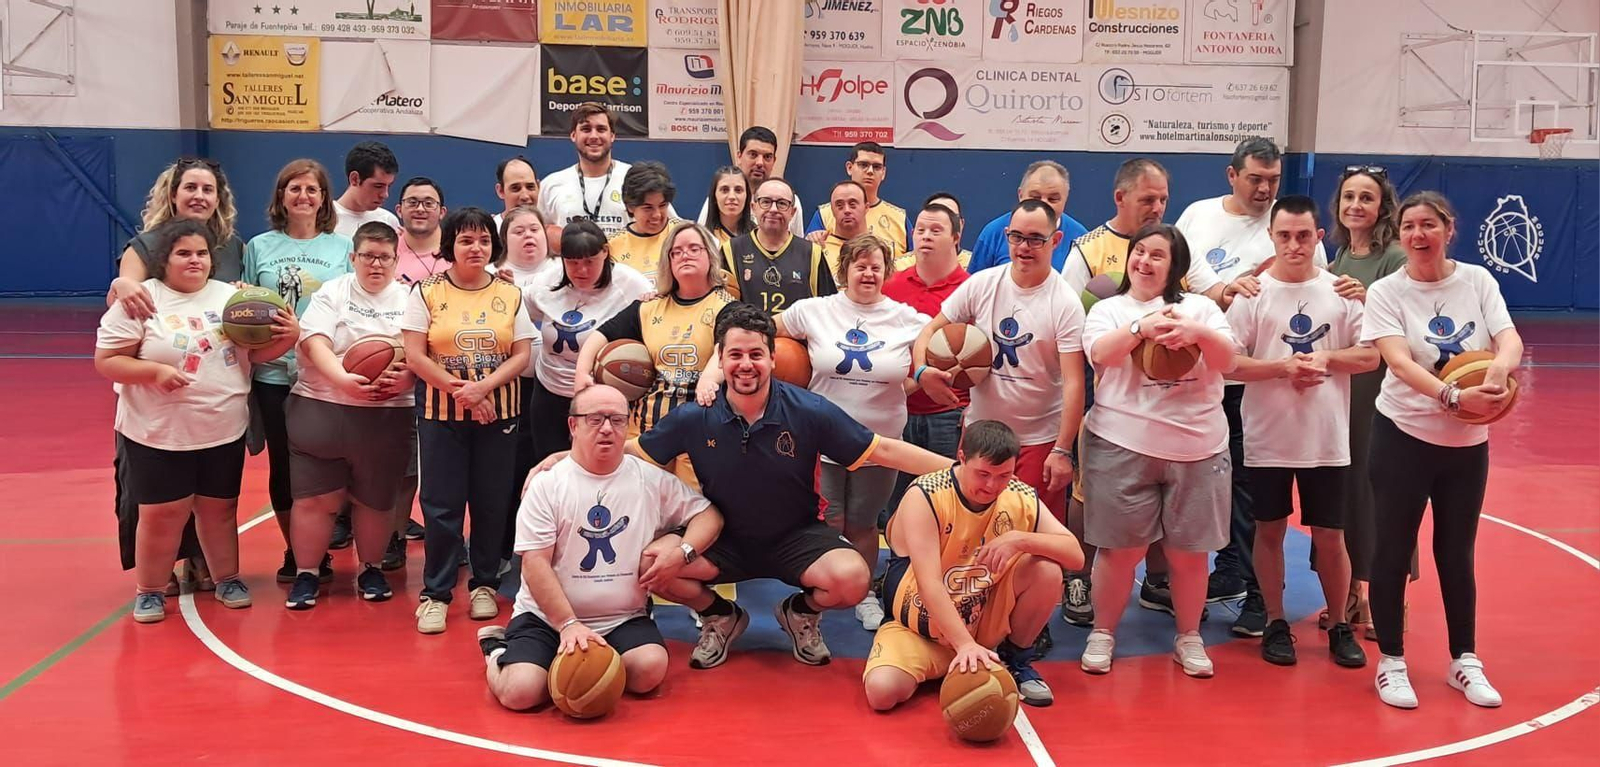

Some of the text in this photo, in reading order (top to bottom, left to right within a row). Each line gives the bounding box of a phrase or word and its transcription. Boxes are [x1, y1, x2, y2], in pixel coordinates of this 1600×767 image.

[554, 2, 633, 13] INMOBILIARIA
[1026, 3, 1063, 18] RIEGOS
[225, 21, 247, 31] Paraje
[321, 24, 335, 32] 699
[337, 24, 351, 32] 428
[386, 26, 399, 34] 373
[401, 26, 415, 34] 032
[555, 13, 633, 32] LAR
[1024, 19, 1077, 35] CARDENAS
[1089, 22, 1179, 34] Construcciones
[810, 30, 865, 41] 959 370 639
[1203, 31, 1275, 41] FONTANERIA
[896, 39, 966, 48] ESPACIO ZENOBIA
[1195, 45, 1282, 54] ANTONIO MORA
[243, 49, 279, 57] RENAULT
[976, 70, 1082, 82] CLINICA DENTAL
[253, 84, 308, 105] MIGUEL
[656, 84, 723, 95] Maurizio M
[376, 94, 423, 107] Platero
[965, 84, 1083, 114] Quirorto
[1197, 121, 1229, 130] turismo
[1231, 124, 1235, 132] y
[269, 256, 296, 267] CAMINO
[760, 291, 786, 313] 12
